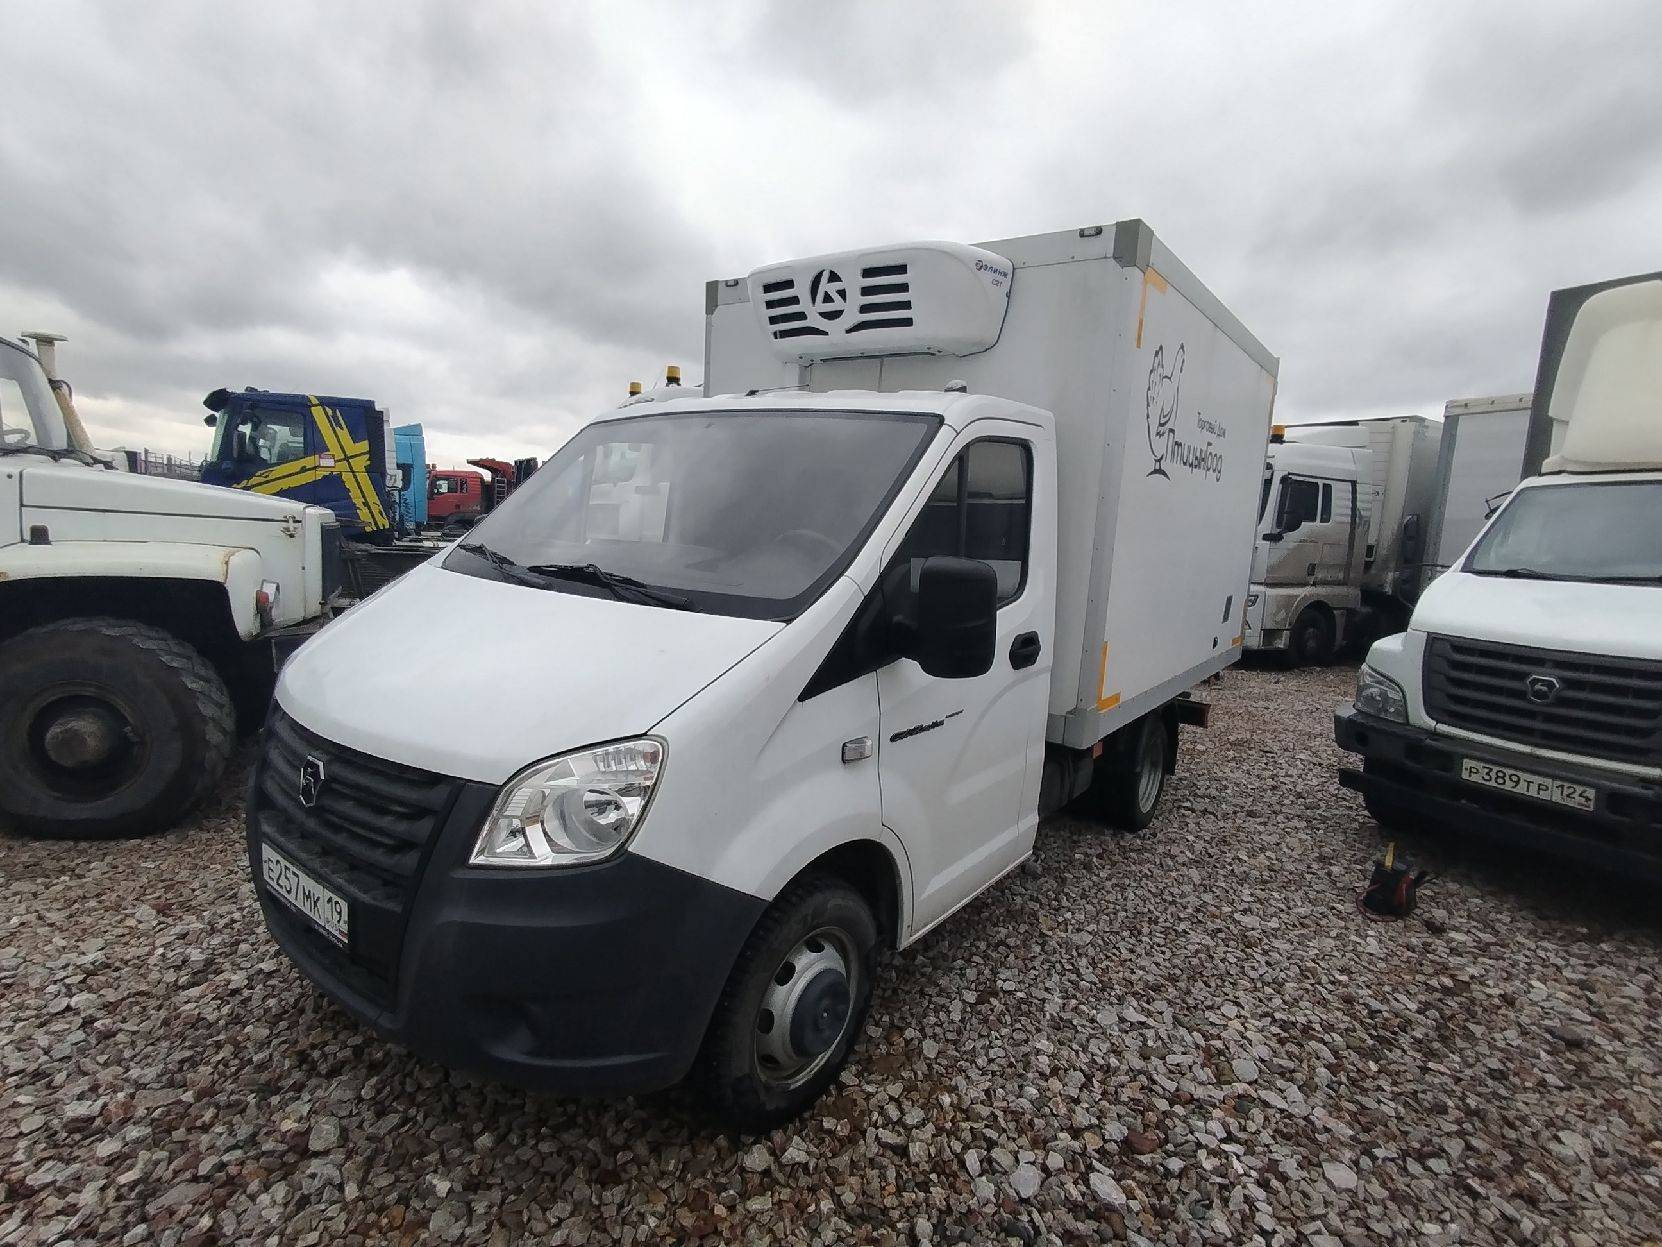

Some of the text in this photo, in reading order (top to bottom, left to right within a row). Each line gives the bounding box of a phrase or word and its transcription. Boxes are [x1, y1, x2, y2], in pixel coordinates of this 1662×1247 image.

[1468, 766, 1592, 803] Р389ТР 124
[267, 857, 342, 923] Е257МК 19
